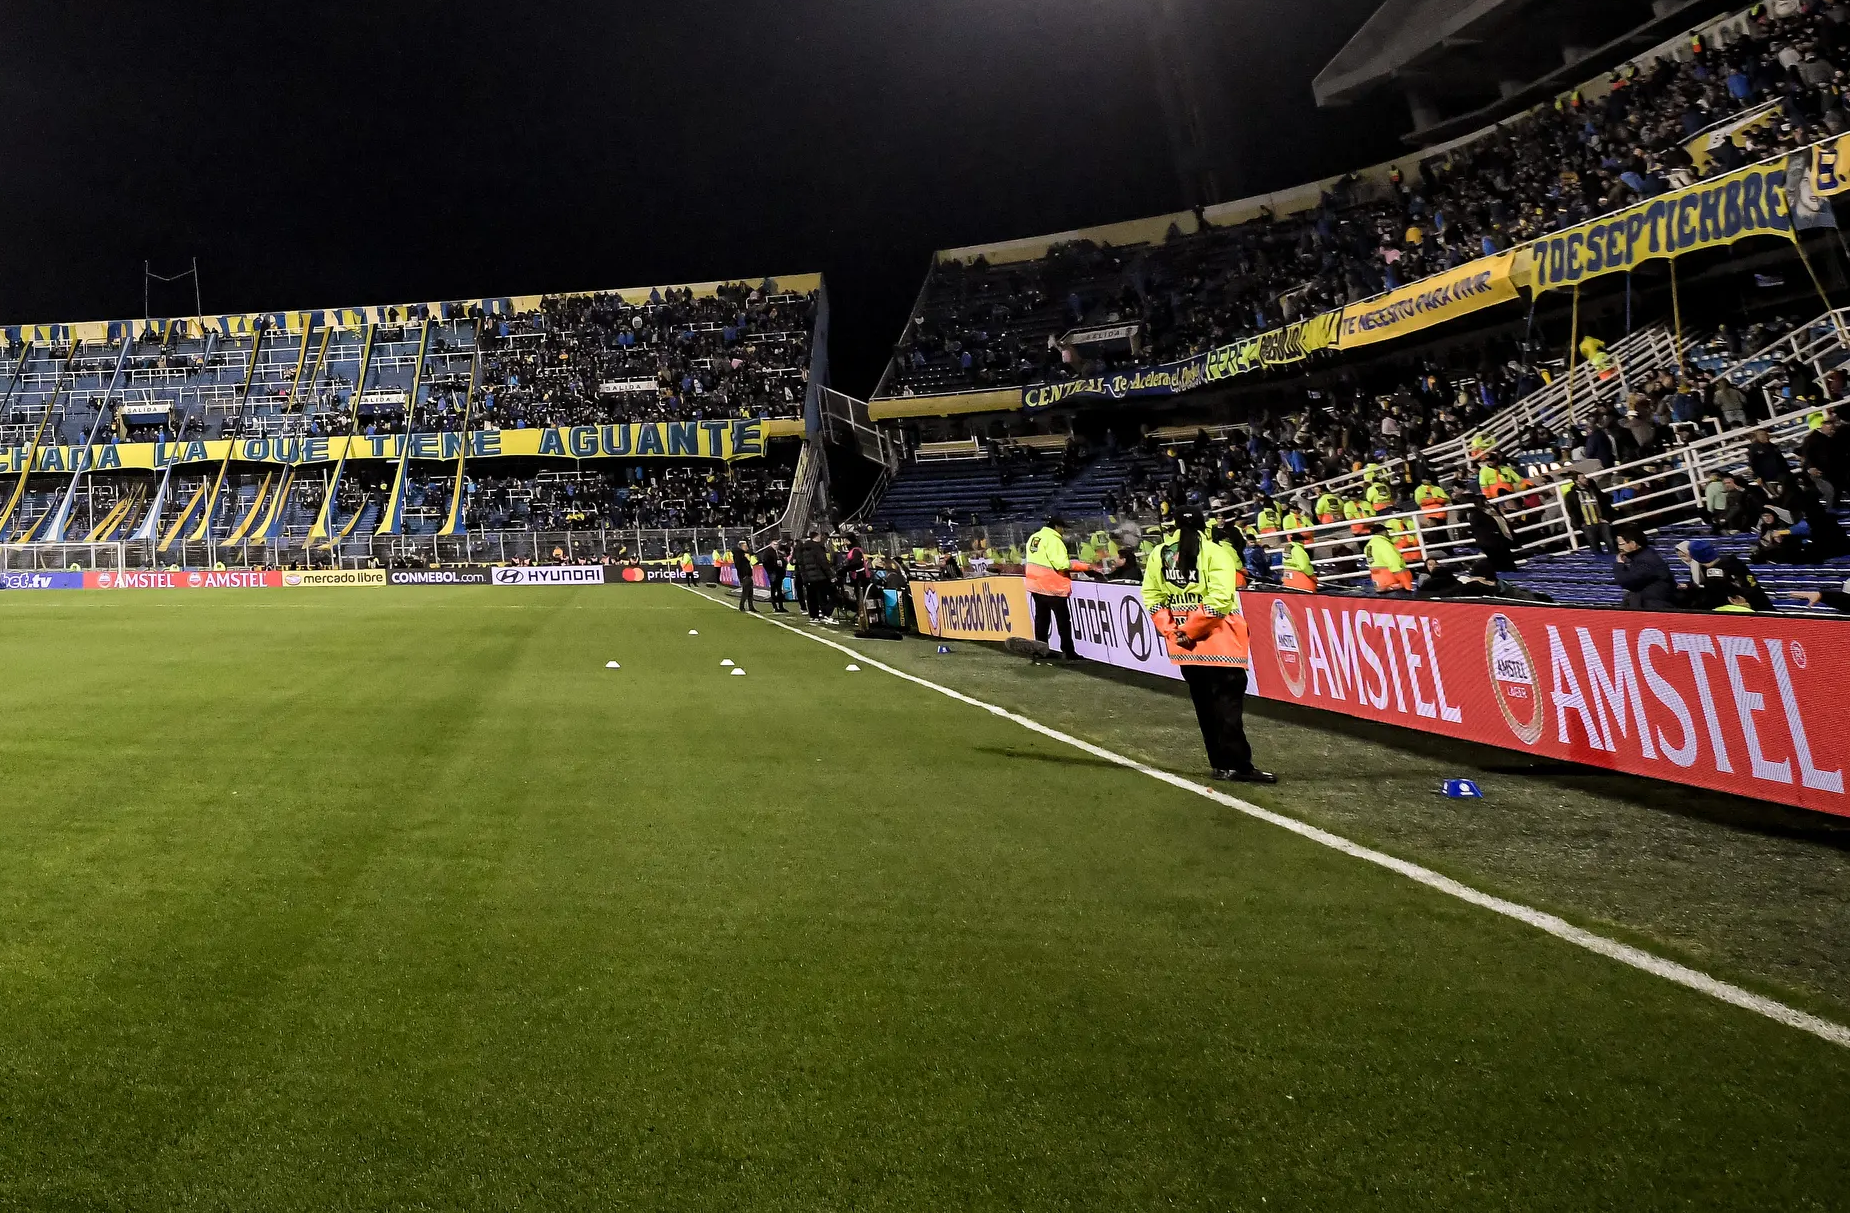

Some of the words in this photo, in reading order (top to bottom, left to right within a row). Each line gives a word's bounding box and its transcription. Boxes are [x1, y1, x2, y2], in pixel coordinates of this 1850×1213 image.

[154, 440, 208, 467] LA
[243, 437, 330, 462] QUE
[365, 429, 501, 458] TIENE
[538, 418, 762, 457] AGUANTE
[114, 573, 175, 587] AMSTEL
[205, 572, 267, 587] AMSTEL
[303, 572, 356, 584] mercado
[357, 571, 384, 584] libre
[527, 567, 601, 582] HYUNDAI
[647, 568, 700, 581] priceles
[940, 583, 985, 632] mercado
[982, 582, 1012, 633] libre
[1305, 607, 1463, 724] AMSTEL
[1496, 659, 1529, 680] AMSTEL
[1545, 624, 1845, 794] AMSTEL
